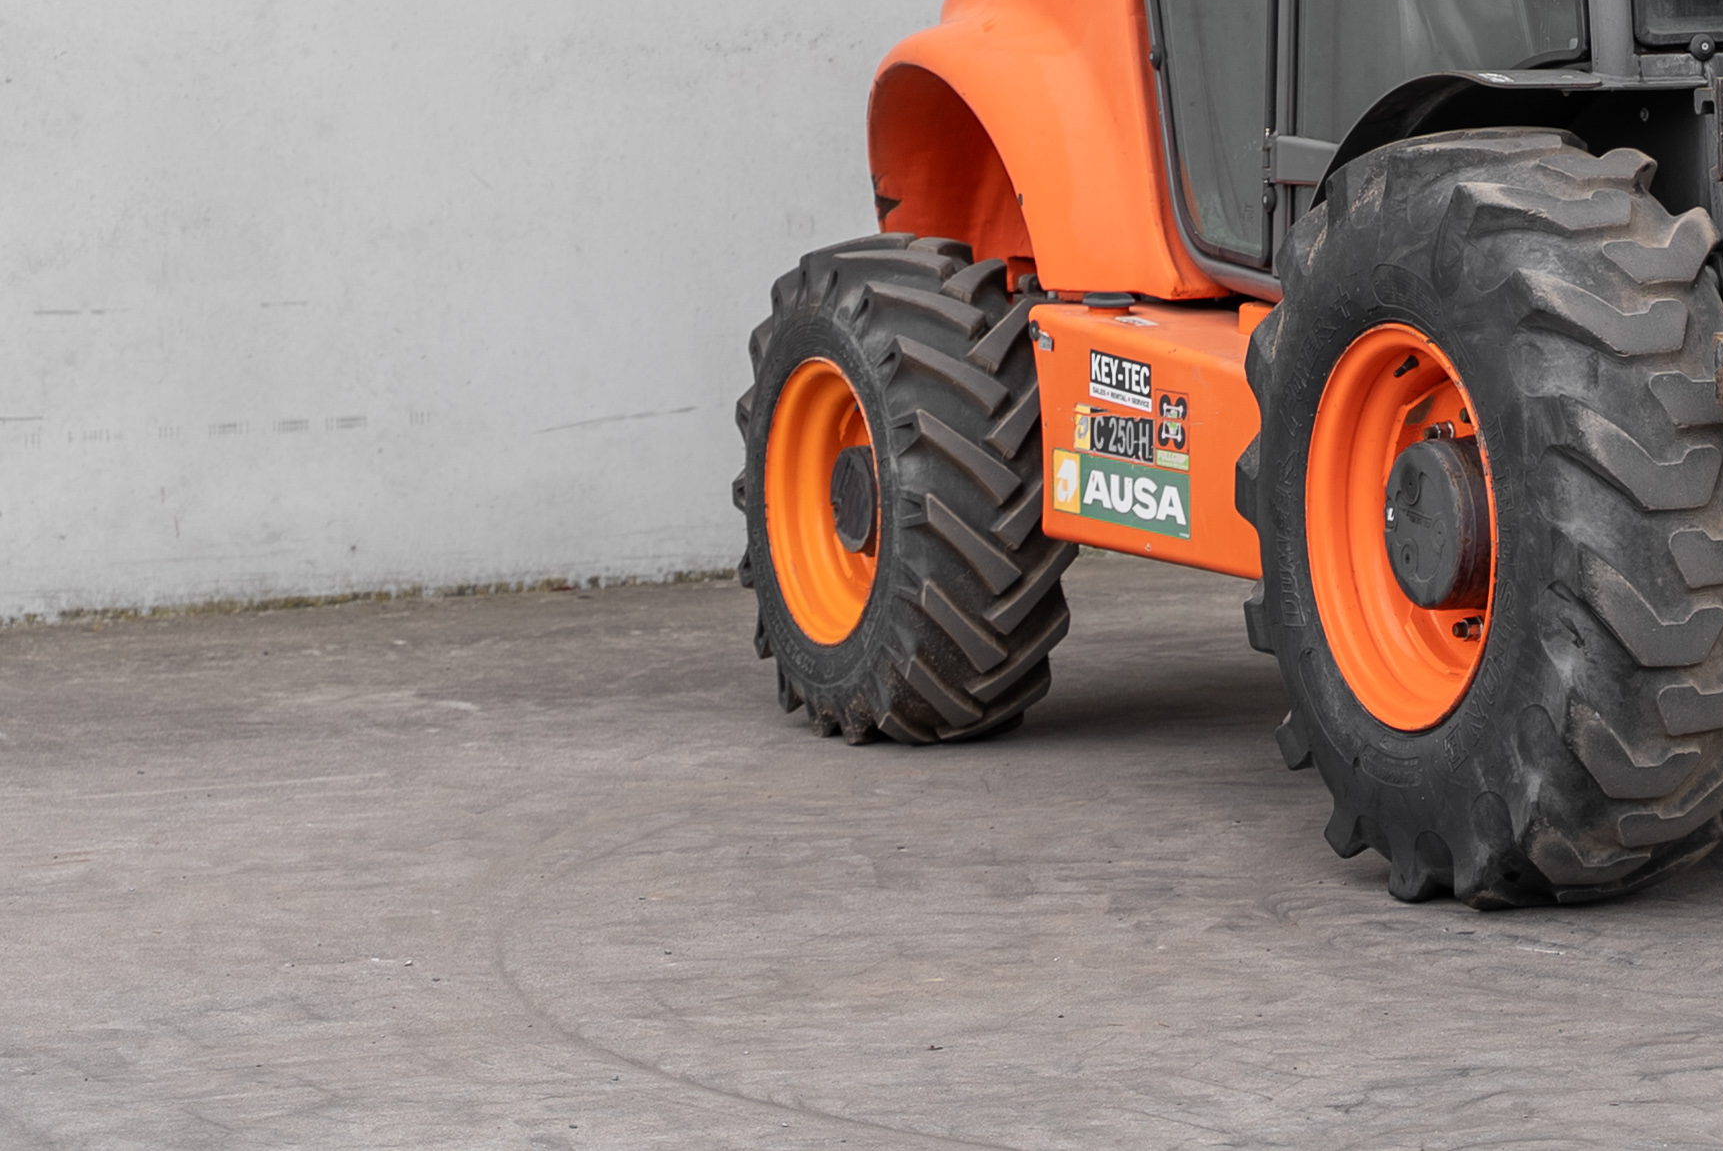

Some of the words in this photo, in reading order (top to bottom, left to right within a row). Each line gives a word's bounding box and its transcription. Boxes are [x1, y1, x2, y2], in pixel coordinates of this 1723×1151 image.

[1091, 352, 1151, 395] KEY-TEC
[1092, 386, 1106, 396] SALES
[1094, 416, 1105, 449] C
[1083, 469, 1187, 526] AUSA
